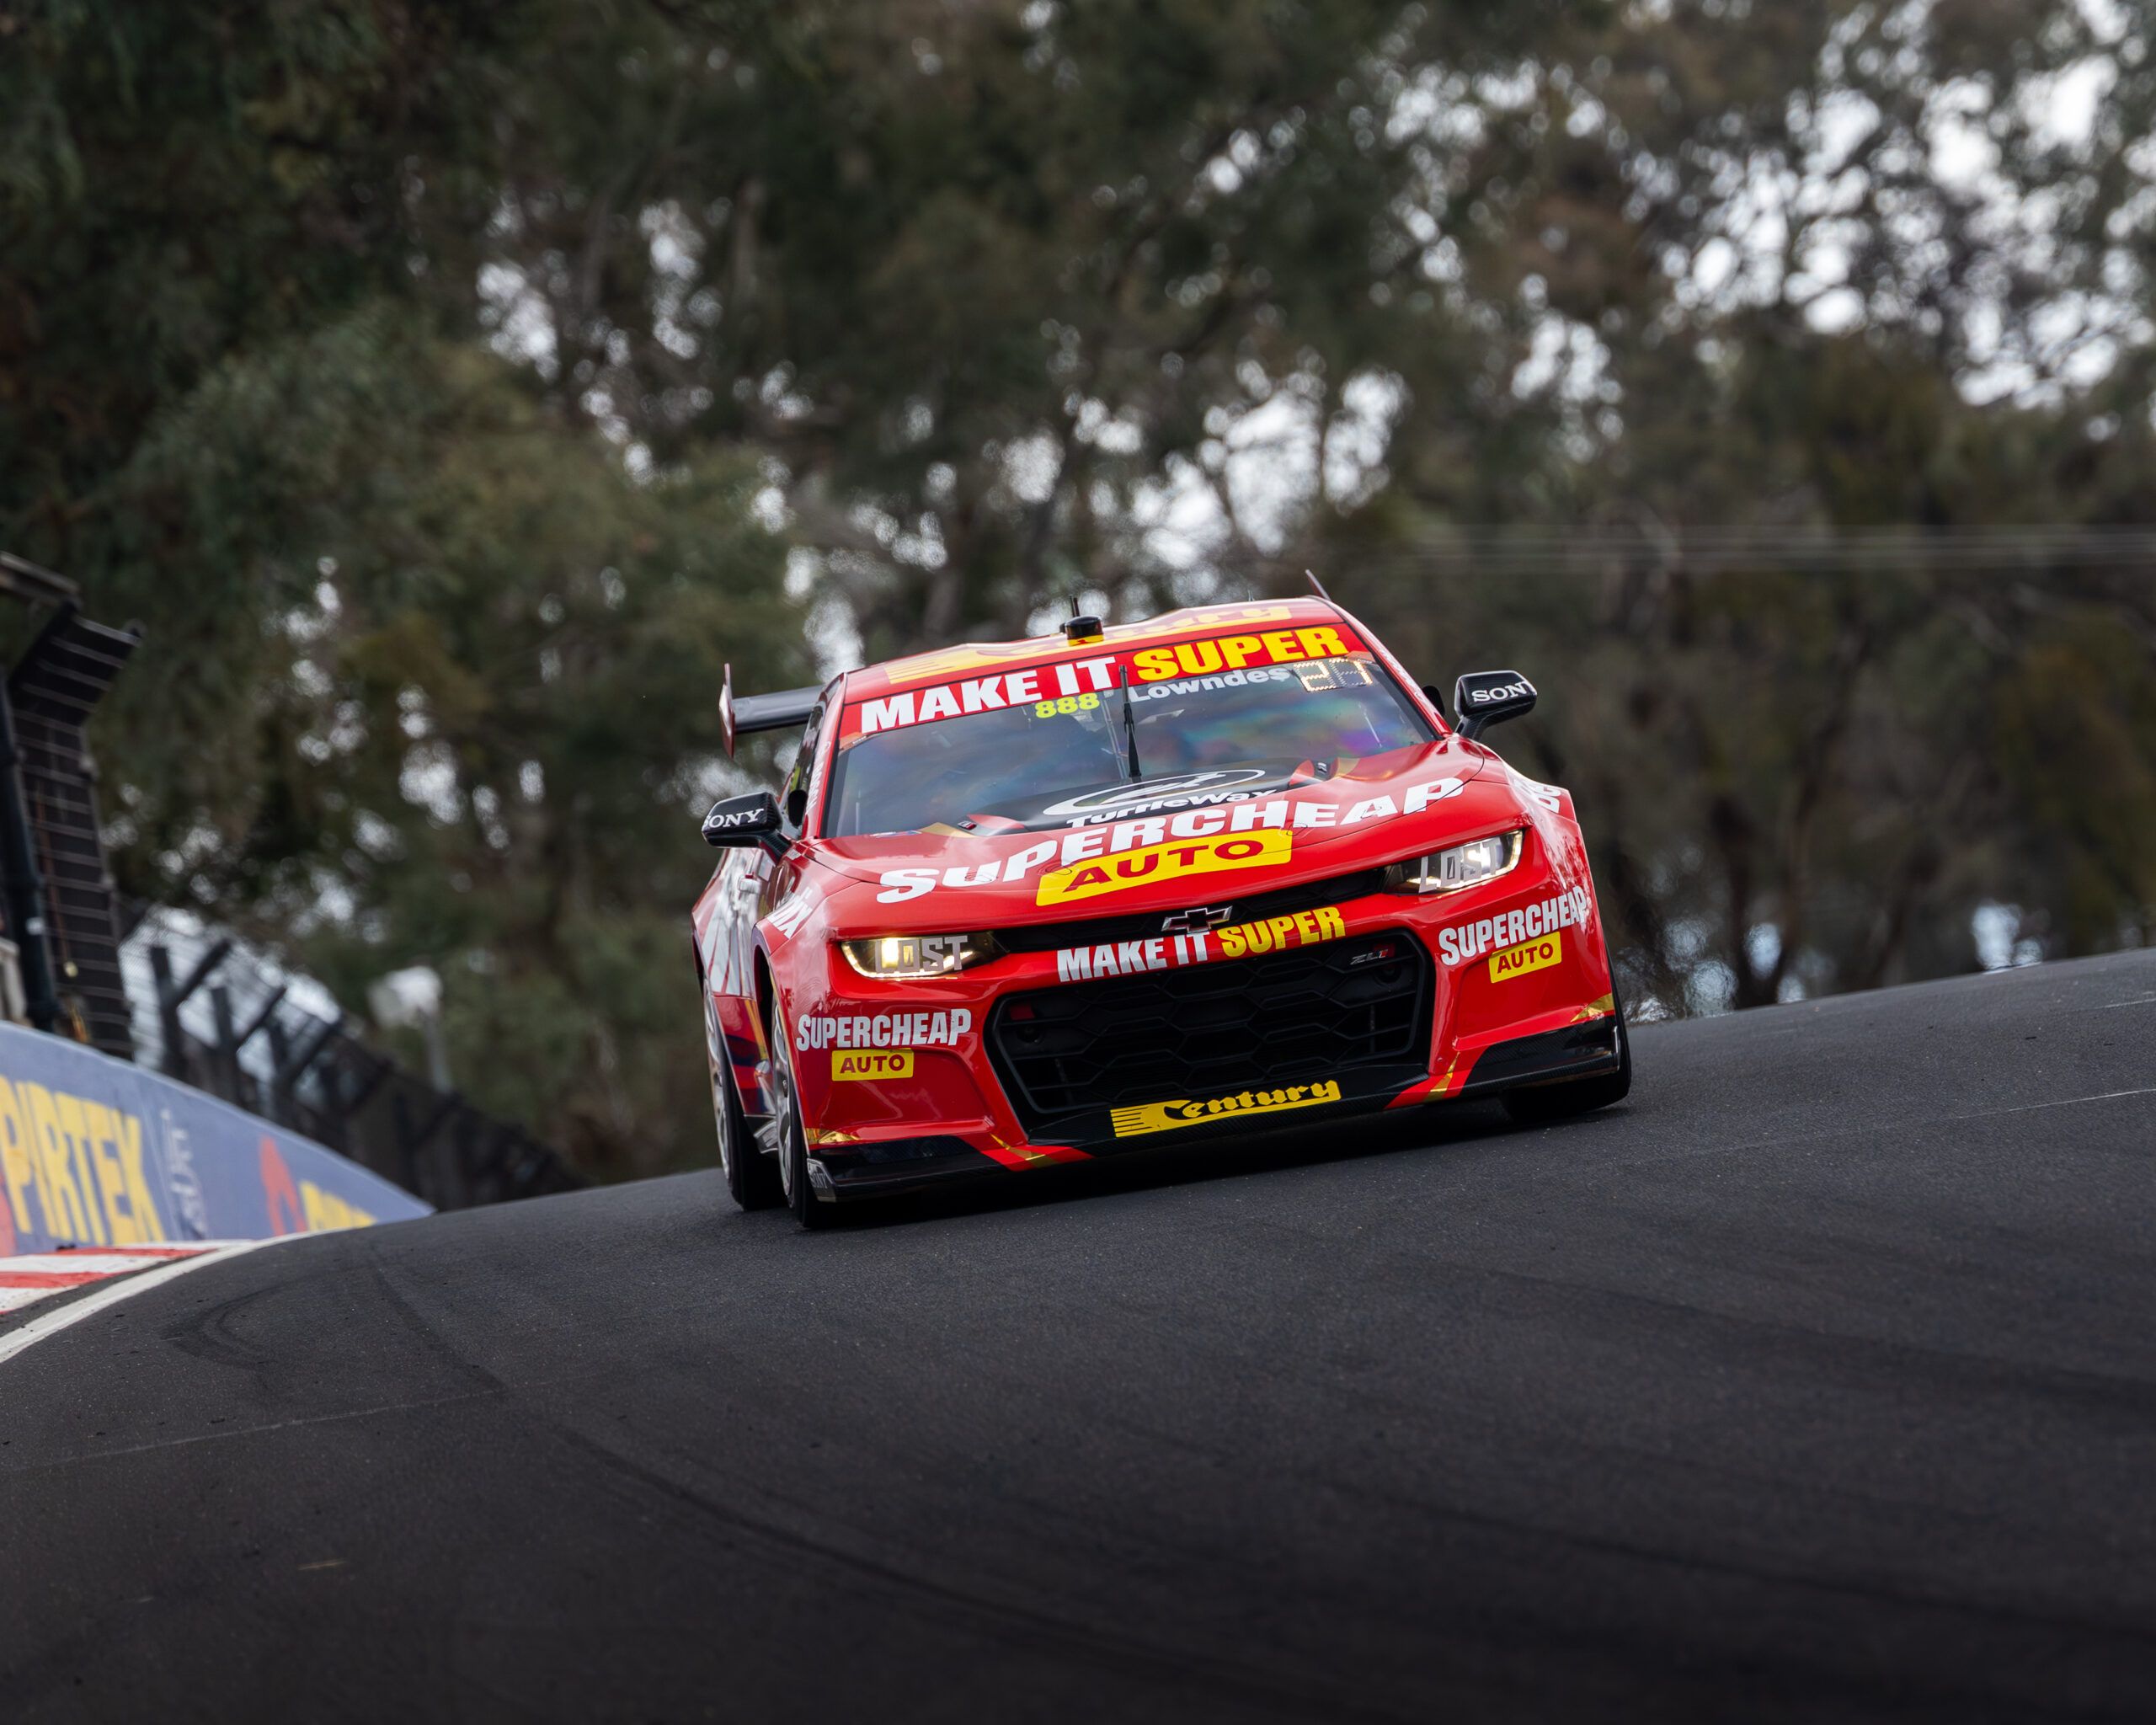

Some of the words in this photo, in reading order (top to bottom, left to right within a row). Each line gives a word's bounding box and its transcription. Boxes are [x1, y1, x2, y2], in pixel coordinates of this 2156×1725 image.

[861, 670, 1042, 734] MAKE
[1054, 656, 1116, 695] IT
[1133, 627, 1349, 681] SUPER
[1035, 692, 1100, 718] 888
[1129, 666, 1292, 702] Lowndes
[1471, 681, 1534, 702] SON
[876, 777, 1464, 904] SUPERCHEAP
[1064, 839, 1264, 893] AUTO
[1419, 836, 1502, 894] LOST
[1056, 939, 1168, 982] MAKE
[1175, 932, 1210, 964] IT
[1217, 906, 1346, 958] SUPER
[1438, 885, 1588, 966] SUPERCHEAP
[875, 935, 968, 973] LOST
[1497, 943, 1554, 974] AUTO
[796, 1008, 972, 1051] SUPERCHEAP
[840, 1054, 905, 1073] AUTO
[1162, 1080, 1342, 1121] Century
[0, 1074, 167, 1247] PIRTEK
